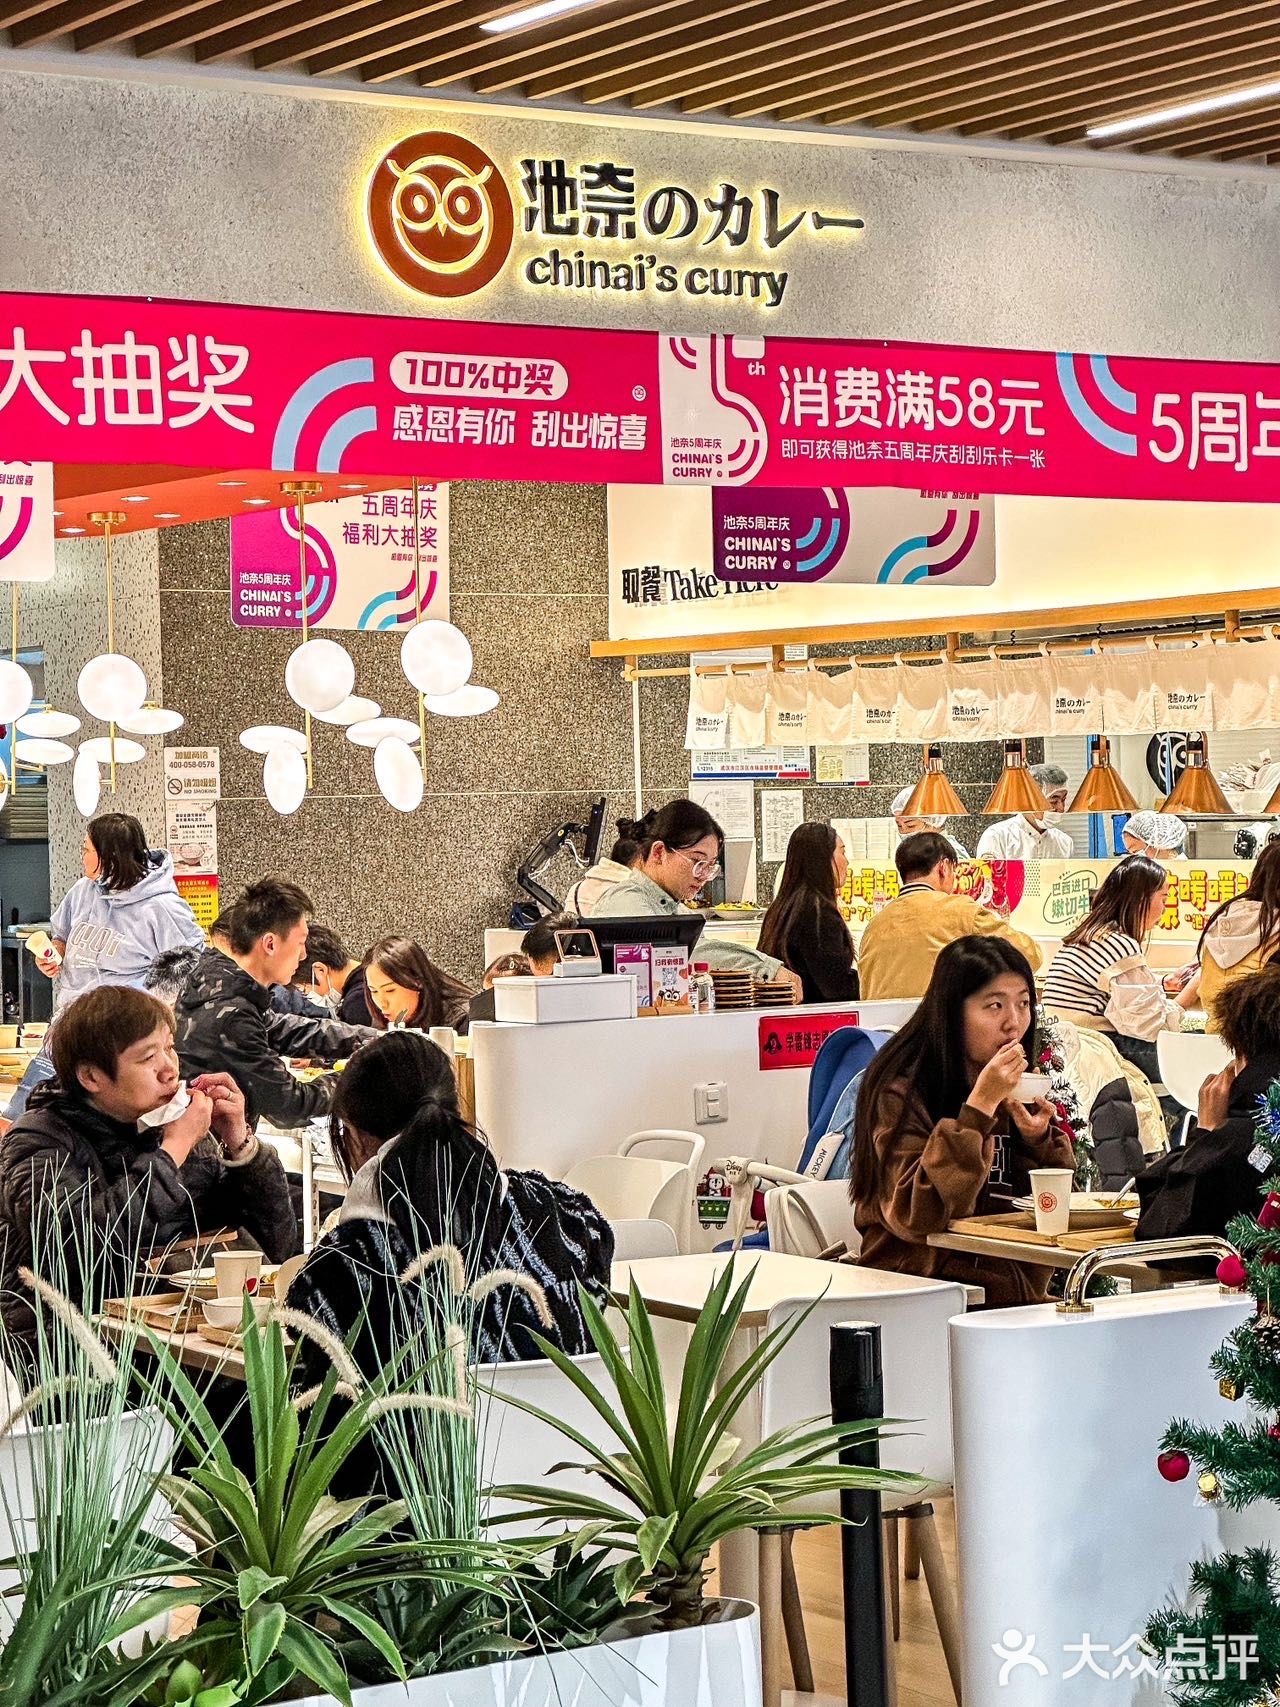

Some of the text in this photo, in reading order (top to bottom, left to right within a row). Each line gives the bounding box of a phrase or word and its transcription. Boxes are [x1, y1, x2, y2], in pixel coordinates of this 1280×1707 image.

[520, 157, 865, 248] 池奈のカレー
[526, 249, 788, 307] chinai's curry
[0, 327, 254, 434] 大抽奖
[403, 358, 554, 396] 100%中奖
[779, 366, 1045, 436] 消费满58元
[393, 404, 648, 450] 感恩有你 刮出惊喜
[670, 436, 722, 449] 池奈5周年庆
[781, 439, 1046, 468] 即可获得池奈五周年庆刮刮乐卡一张
[672, 467, 712, 478] CURRY
[362, 494, 438, 520] 五周年庆
[342, 521, 438, 549] 福利大抽奖
[723, 515, 791, 532] 池奈5周年庆
[725, 556, 777, 571] CURRY
[239, 571, 292, 586] 池奈5周年庆
[664, 567, 719, 601] Take
[240, 604, 281, 618] CURRY
[169, 760, 215, 769] 400-058-0578
[1052, 877, 1091, 897] 巴西进口
[810, 1148, 828, 1178] MICKEY
